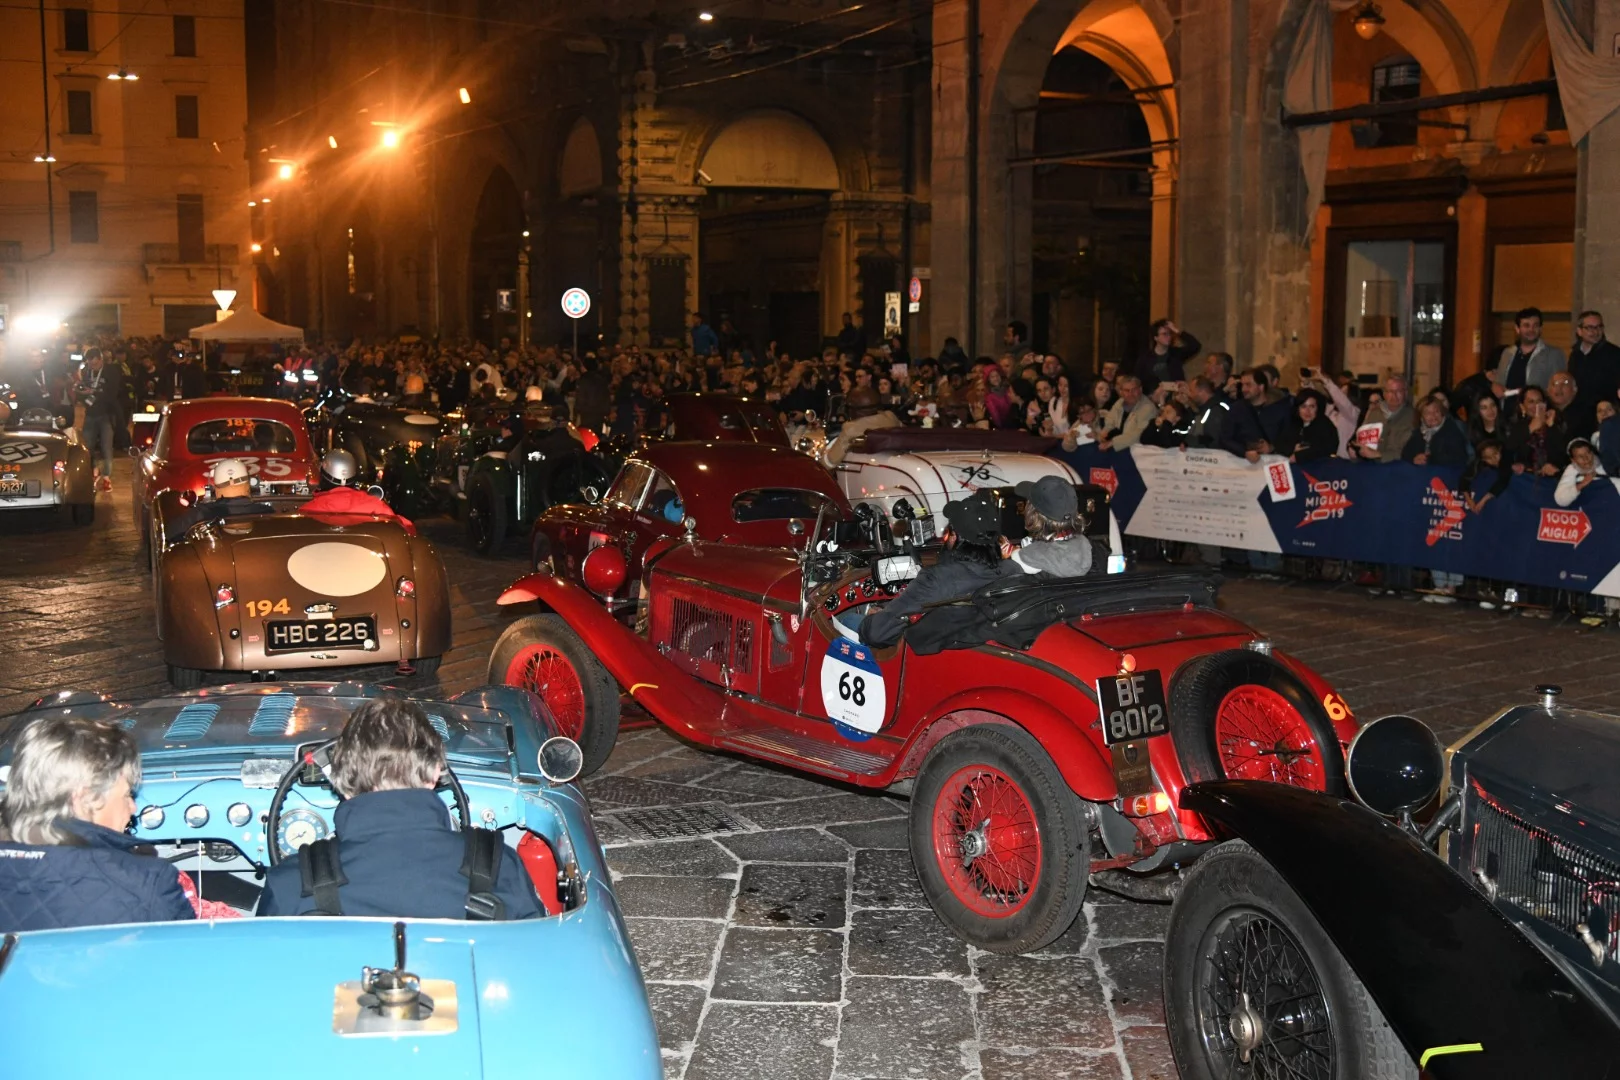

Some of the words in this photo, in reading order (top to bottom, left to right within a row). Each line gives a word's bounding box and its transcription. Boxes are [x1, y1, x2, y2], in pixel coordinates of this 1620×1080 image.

[1308, 479, 1348, 492] 1000
[1305, 494, 1347, 507] MIGLIA
[1422, 497, 1471, 509] BEAUTIFU
[1304, 508, 1345, 521] 2019
[1546, 512, 1579, 526] 1000
[1541, 526, 1579, 540] MIGLIA
[246, 598, 291, 618] 194
[273, 624, 318, 645] HBC
[324, 622, 368, 643] 226
[838, 671, 866, 707] 68
[1116, 675, 1145, 707] BF
[1109, 703, 1165, 739] 8012
